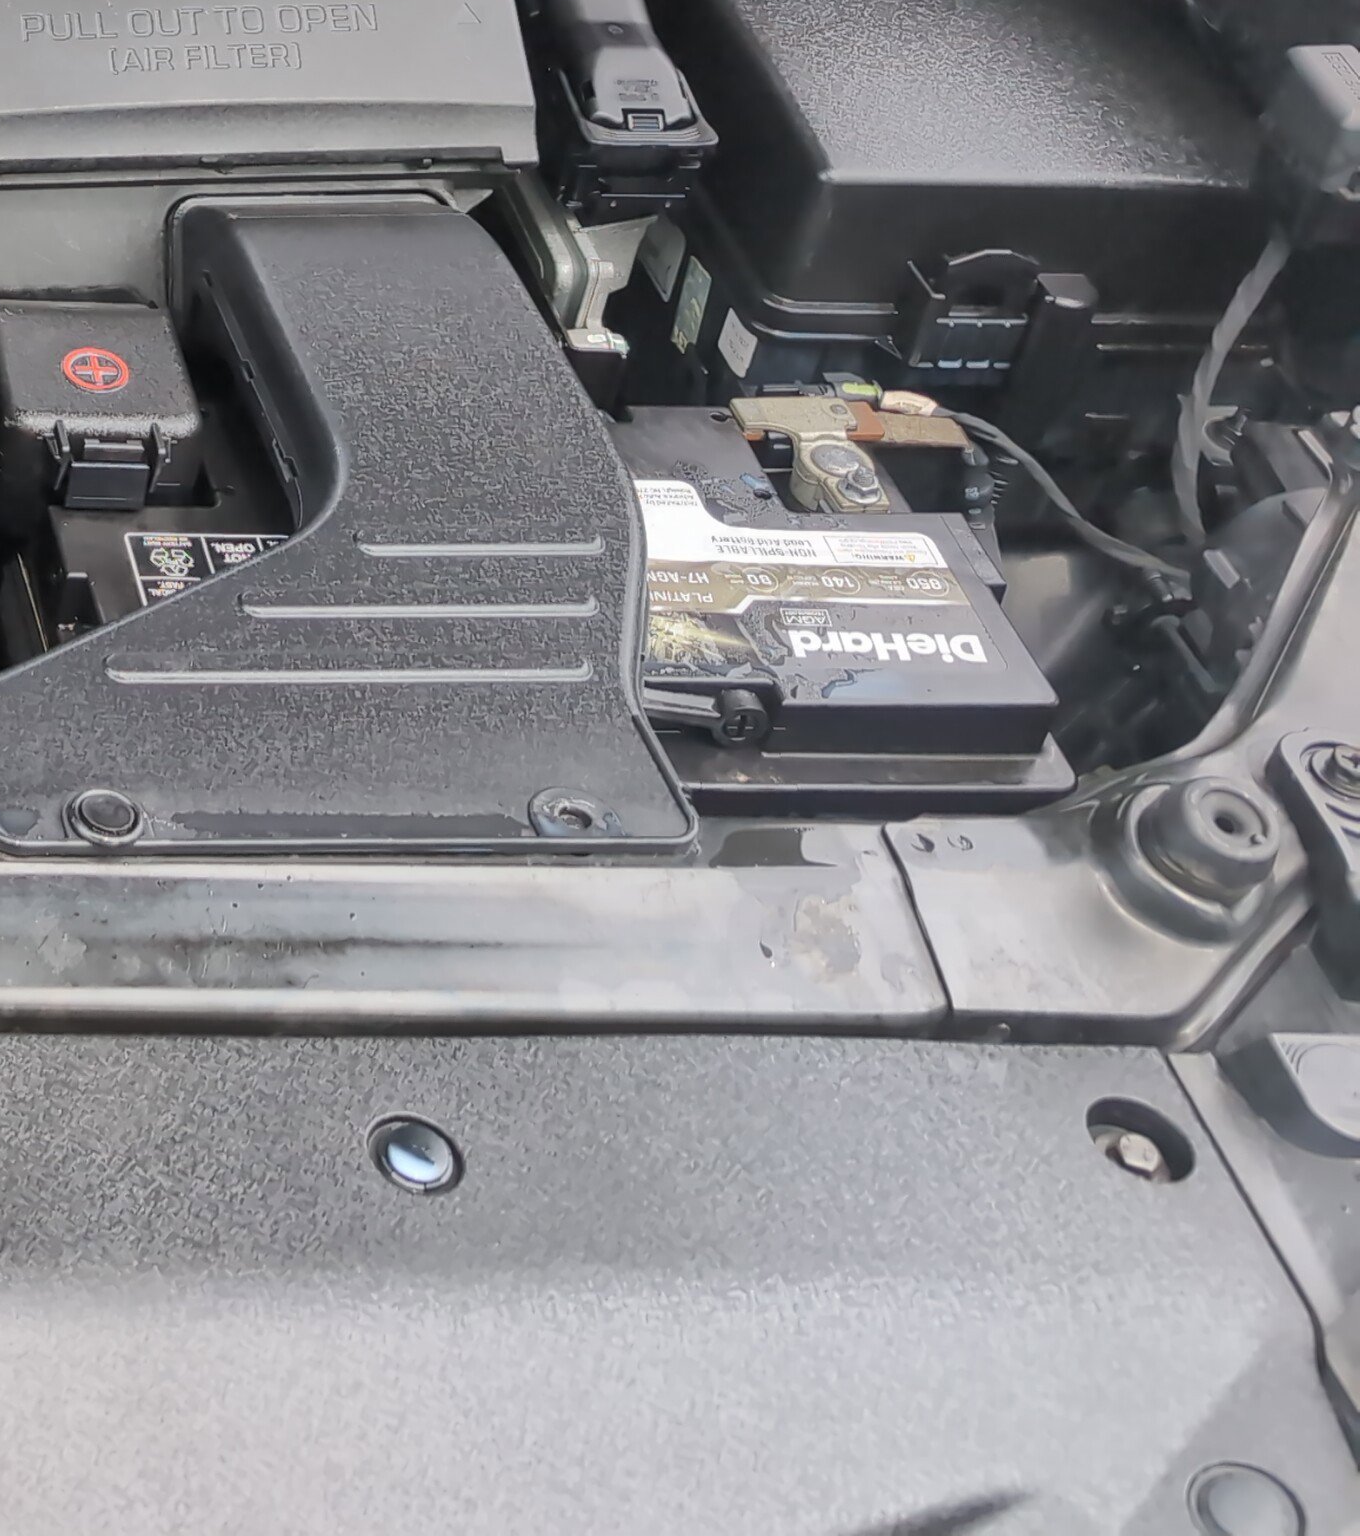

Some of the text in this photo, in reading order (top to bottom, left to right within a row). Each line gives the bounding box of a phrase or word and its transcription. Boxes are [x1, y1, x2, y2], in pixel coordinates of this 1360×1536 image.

[20, 2, 379, 42] PULL OUT TO OPEN
[820, 576, 855, 588] 140
[786, 615, 826, 624] AGM
[787, 629, 988, 663] DieHard
